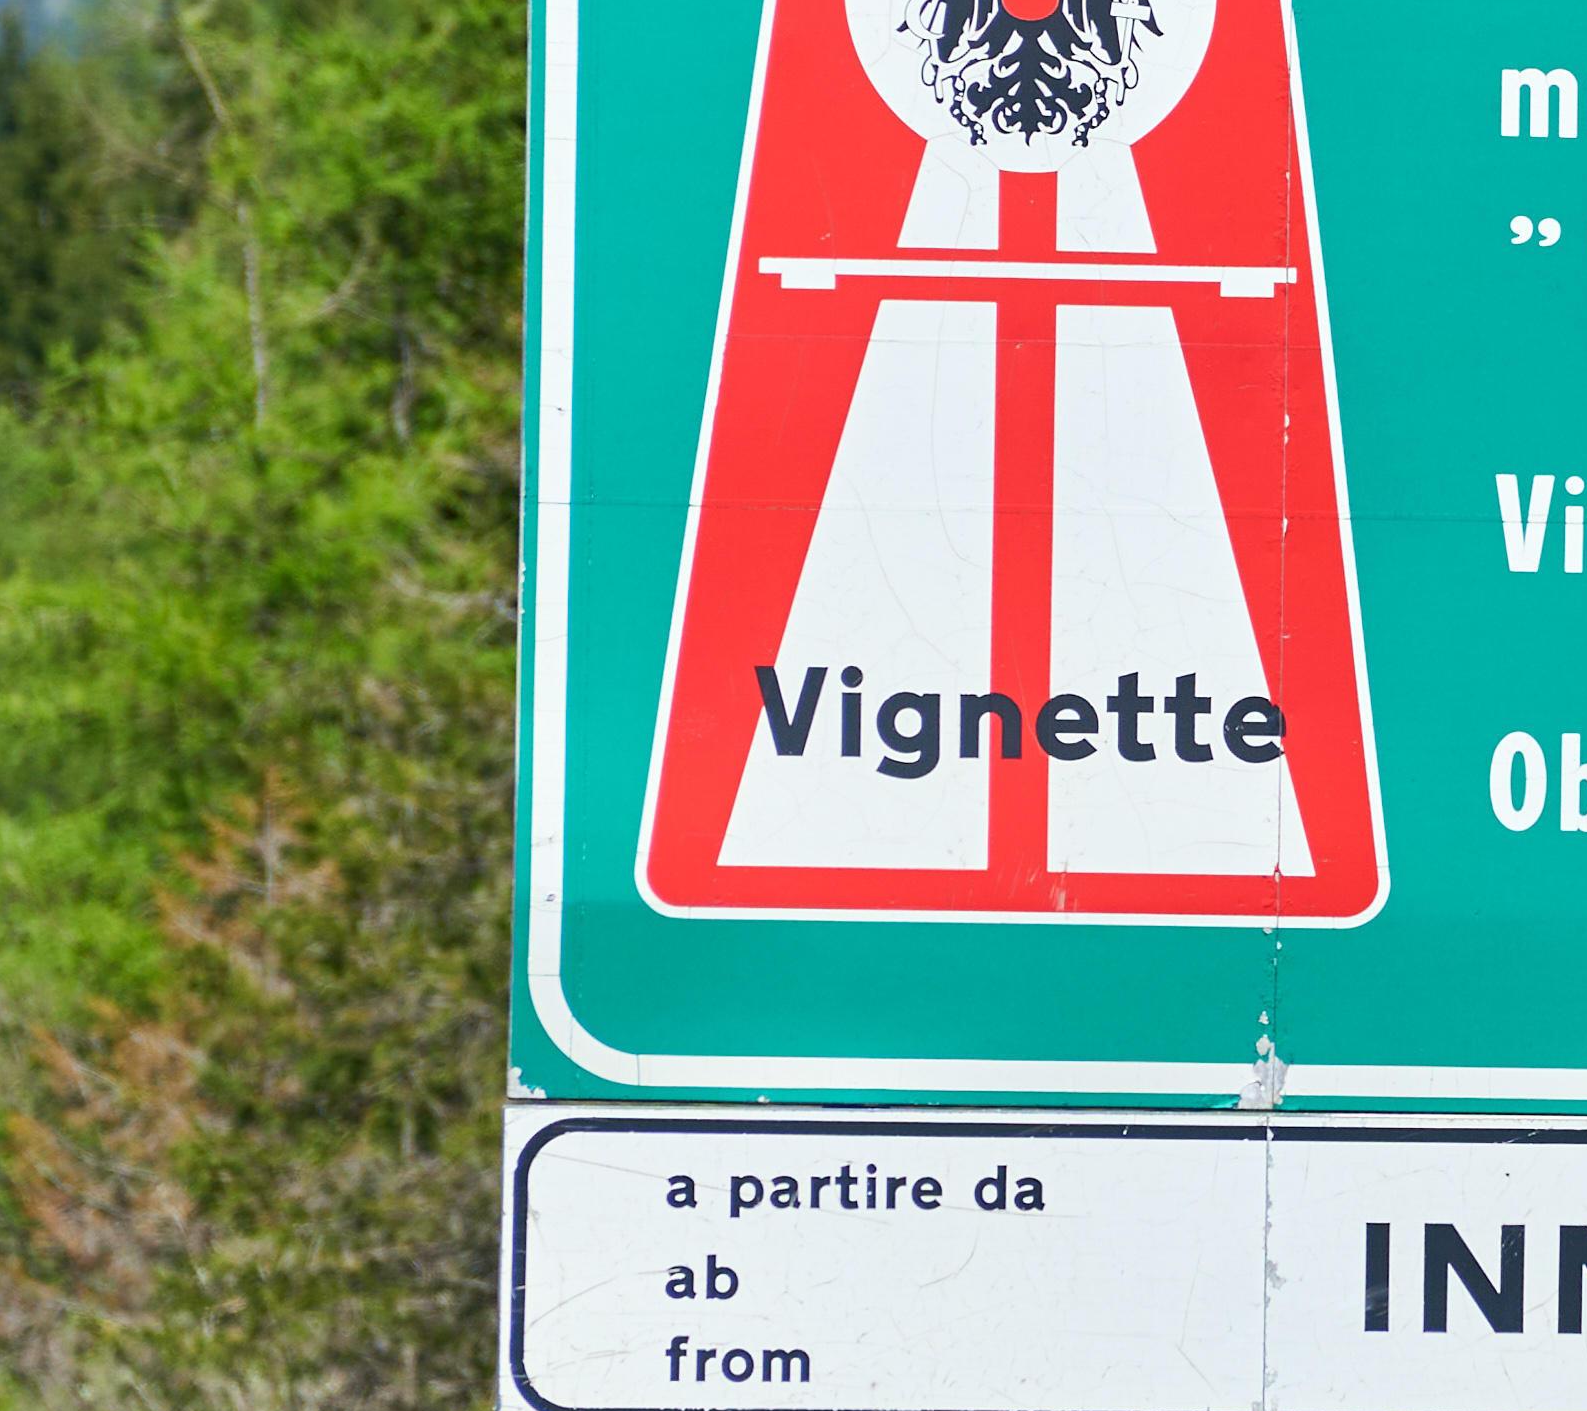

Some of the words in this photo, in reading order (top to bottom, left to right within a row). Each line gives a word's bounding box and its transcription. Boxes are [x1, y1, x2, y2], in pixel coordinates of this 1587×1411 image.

[755, 665, 1286, 779] Vignette
[667, 1174, 698, 1209] a
[730, 1163, 943, 1218] partire
[974, 1165, 1045, 1211] da
[665, 1254, 739, 1301] ab
[667, 1336, 811, 1383] from
